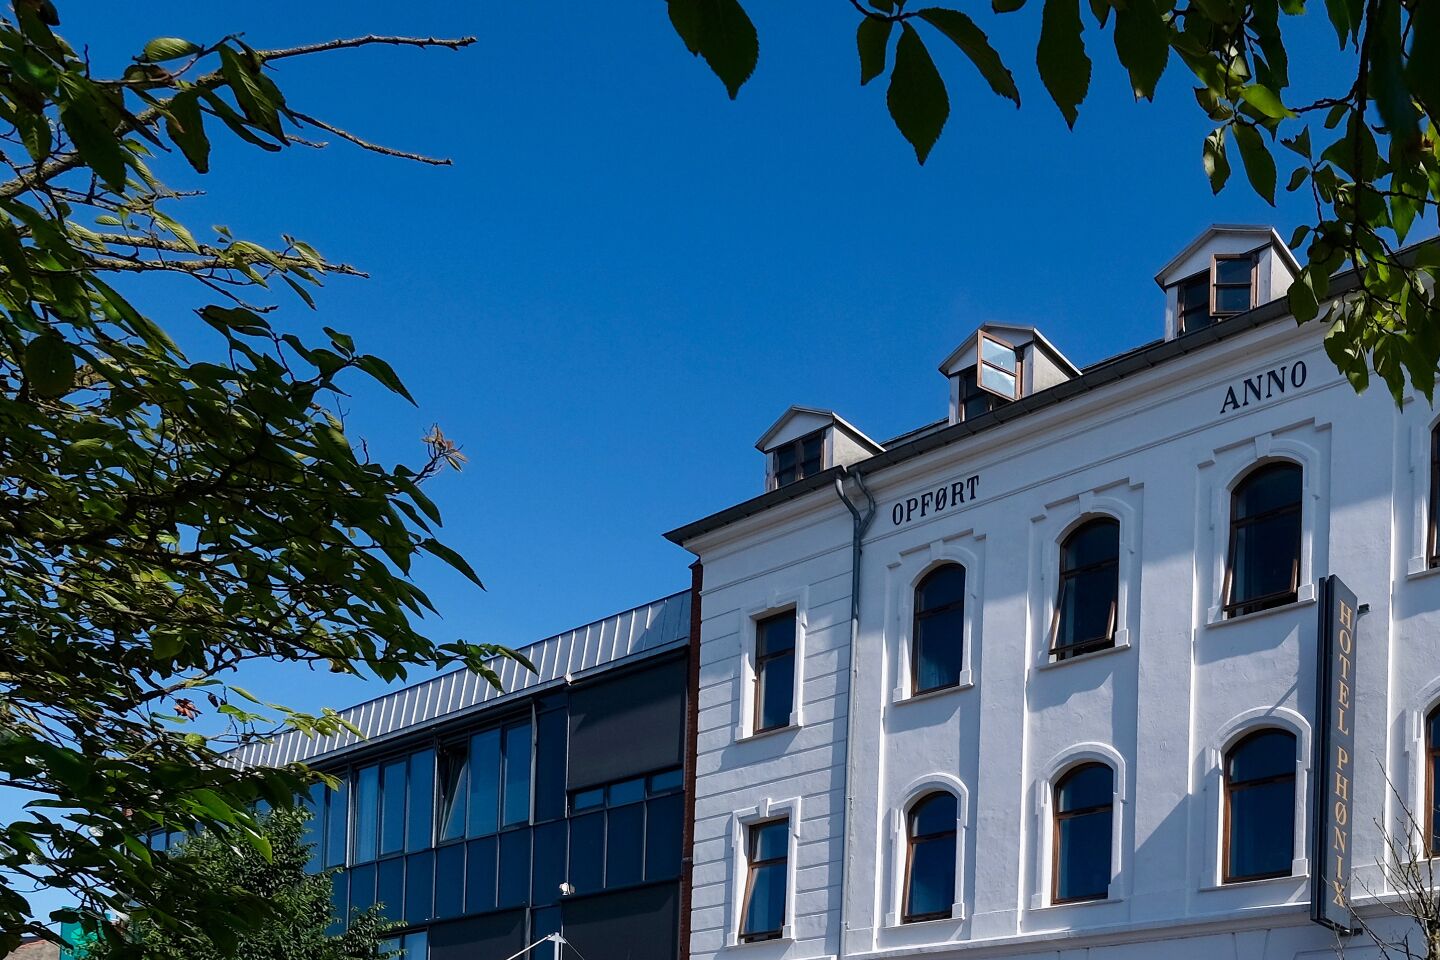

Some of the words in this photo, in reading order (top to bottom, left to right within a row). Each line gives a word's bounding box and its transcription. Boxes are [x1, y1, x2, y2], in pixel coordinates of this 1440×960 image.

[1220, 360, 1307, 414] ANNO
[892, 474, 980, 526] OPFØRT
[1338, 599, 1352, 736] HOTEL
[1333, 745, 1349, 909] PHØNIX
